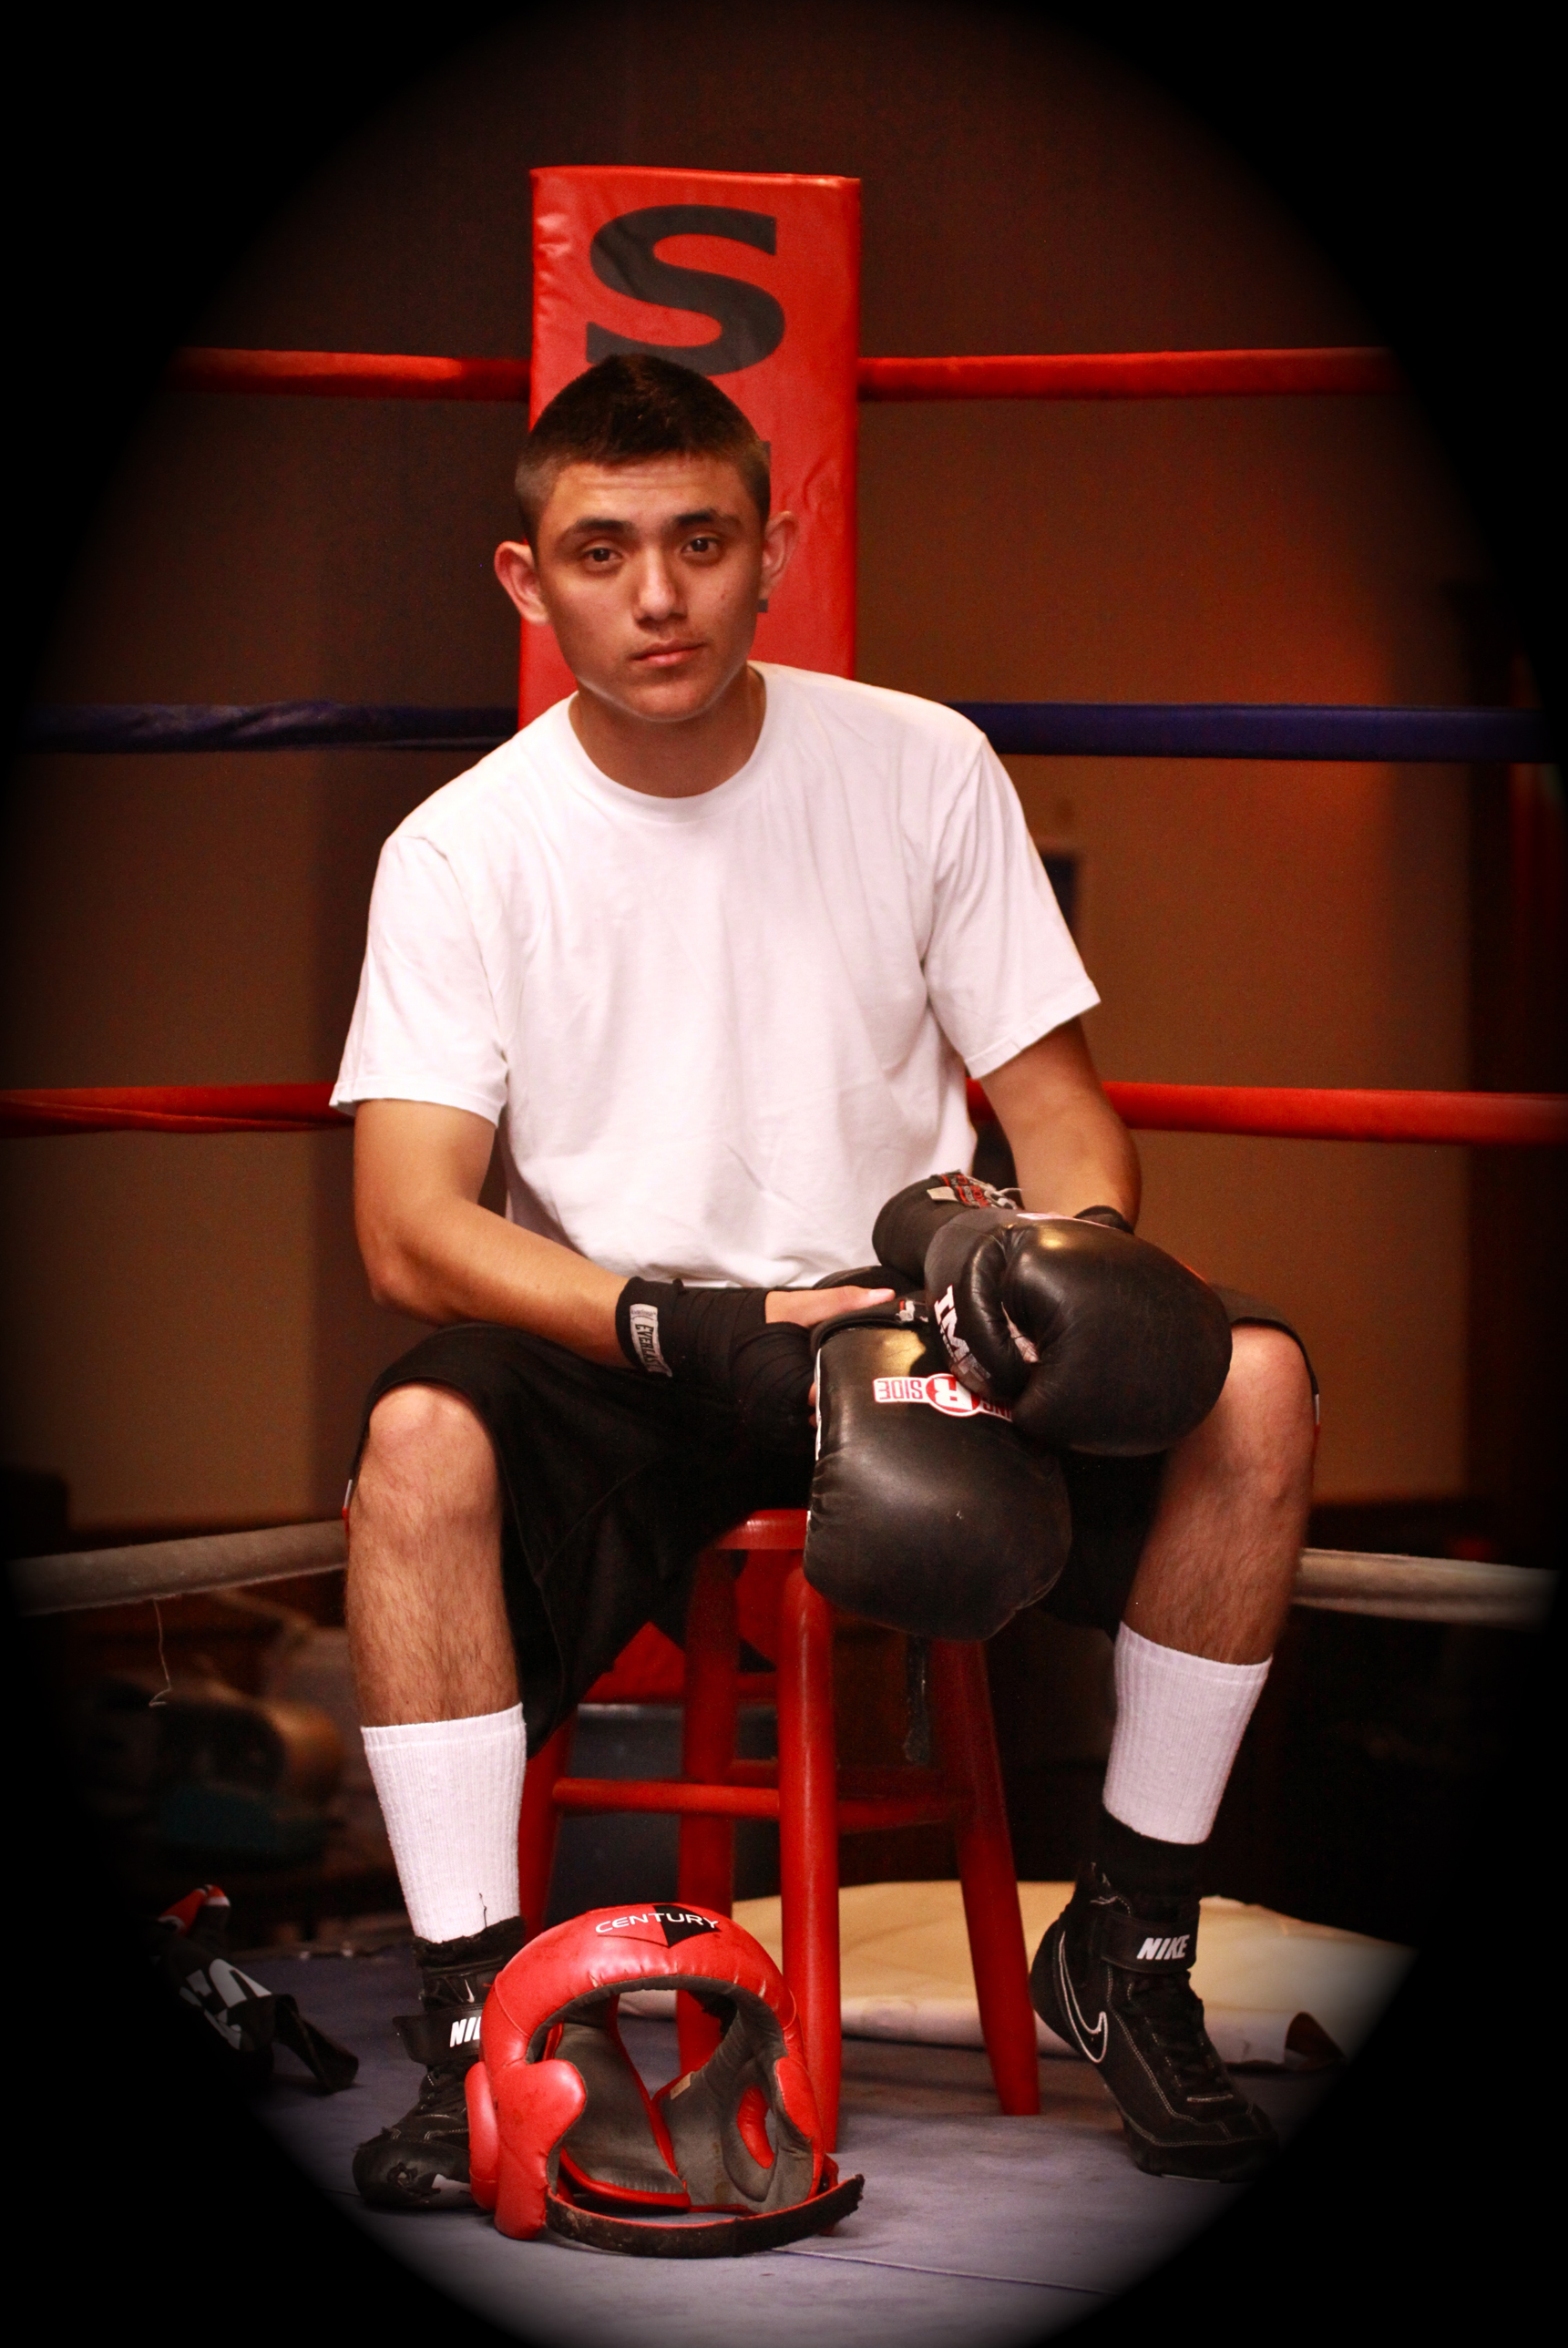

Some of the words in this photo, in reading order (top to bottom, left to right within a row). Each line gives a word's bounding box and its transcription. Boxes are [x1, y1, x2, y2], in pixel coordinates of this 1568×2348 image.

[586, 203, 786, 377] S
[877, 1379, 924, 1400] SIDE
[595, 1912, 721, 1933] CENTURY
[1136, 1934, 1191, 1960] NIKE
[449, 2015, 482, 2049] NI
